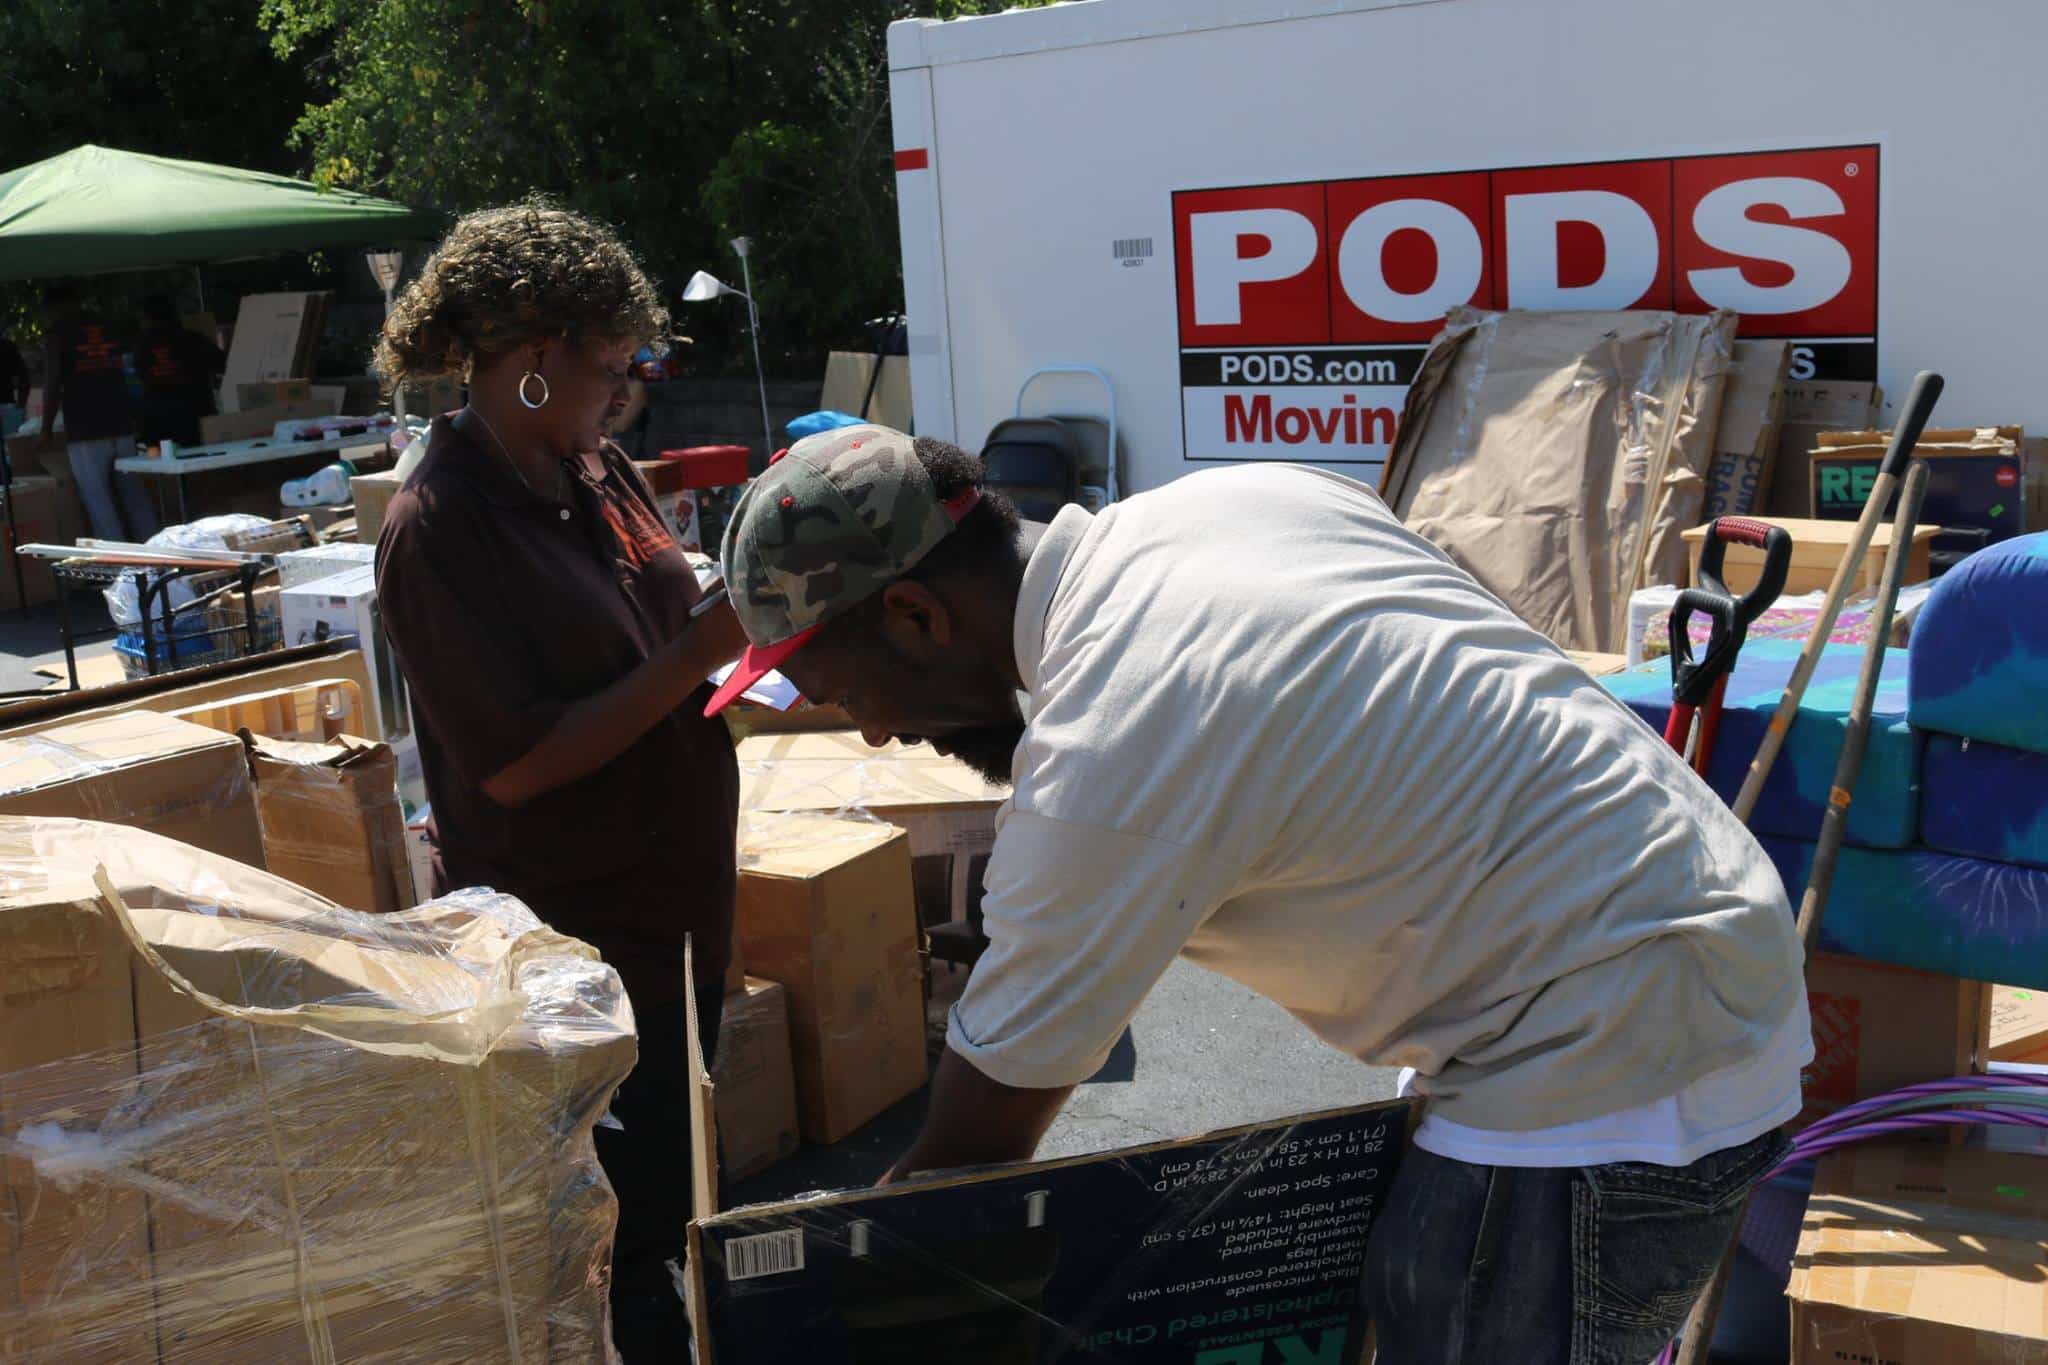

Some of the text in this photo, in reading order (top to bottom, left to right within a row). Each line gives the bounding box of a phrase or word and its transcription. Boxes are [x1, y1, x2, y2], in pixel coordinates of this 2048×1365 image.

[1189, 175, 1852, 326] PODS
[1220, 354, 1396, 383] PODS.com
[1224, 394, 1404, 444] Movin
[1821, 466, 1877, 503] RE
[1318, 1132, 1342, 1146] cm
[1348, 1124, 1386, 1144] (71.1
[1236, 1148, 1259, 1160] cm
[1327, 1147, 1340, 1160] H
[1346, 1144, 1360, 1156] in
[1364, 1140, 1384, 1153] 28
[1196, 1158, 1215, 1170] 73
[1269, 1157, 1284, 1168] in
[1288, 1152, 1308, 1166] 23
[1160, 1163, 1190, 1178] cm)
[1154, 1180, 1167, 1192] D
[1173, 1176, 1187, 1188] in
[1243, 1167, 1378, 1200] Care: Spot clean.
[1340, 1193, 1374, 1210] Seat
[1279, 1200, 1335, 1219] height:
[1221, 1219, 1235, 1232] in
[1225, 1209, 1370, 1246] hardware included
[1293, 1224, 1368, 1245] Assembly
[1286, 1246, 1318, 1260] legs
[1127, 1249, 1363, 1302] Upholstered construction with
[1224, 1266, 1360, 1298] Black microsuede
